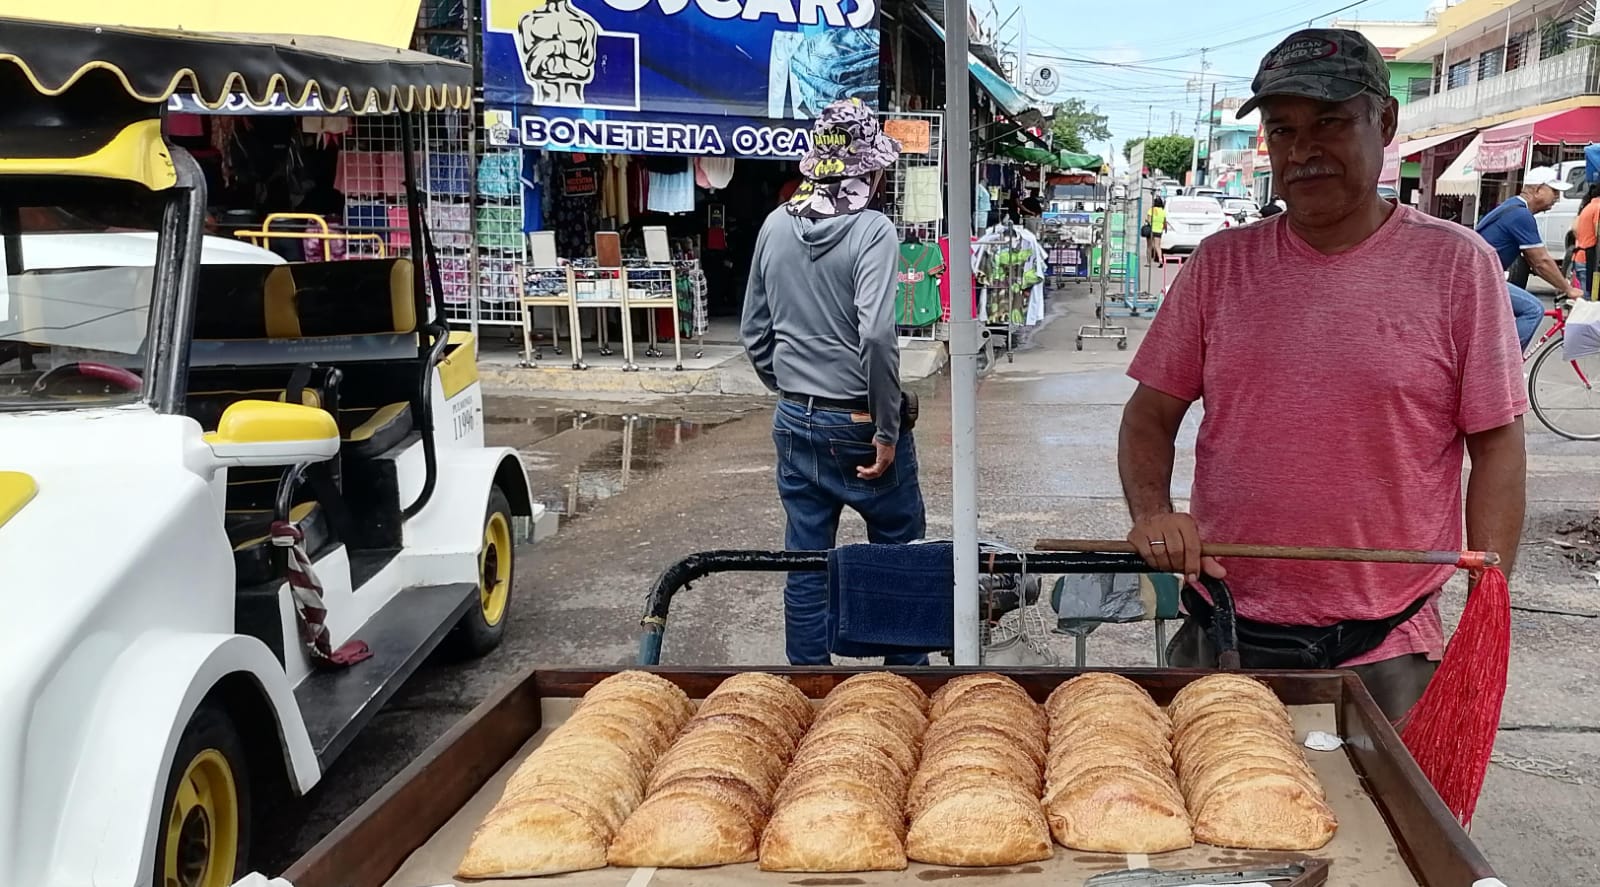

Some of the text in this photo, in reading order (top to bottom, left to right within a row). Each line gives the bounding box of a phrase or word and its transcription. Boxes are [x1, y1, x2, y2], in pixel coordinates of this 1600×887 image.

[521, 116, 814, 157] BONETERIA OSCA
[815, 134, 846, 145] BATMAN
